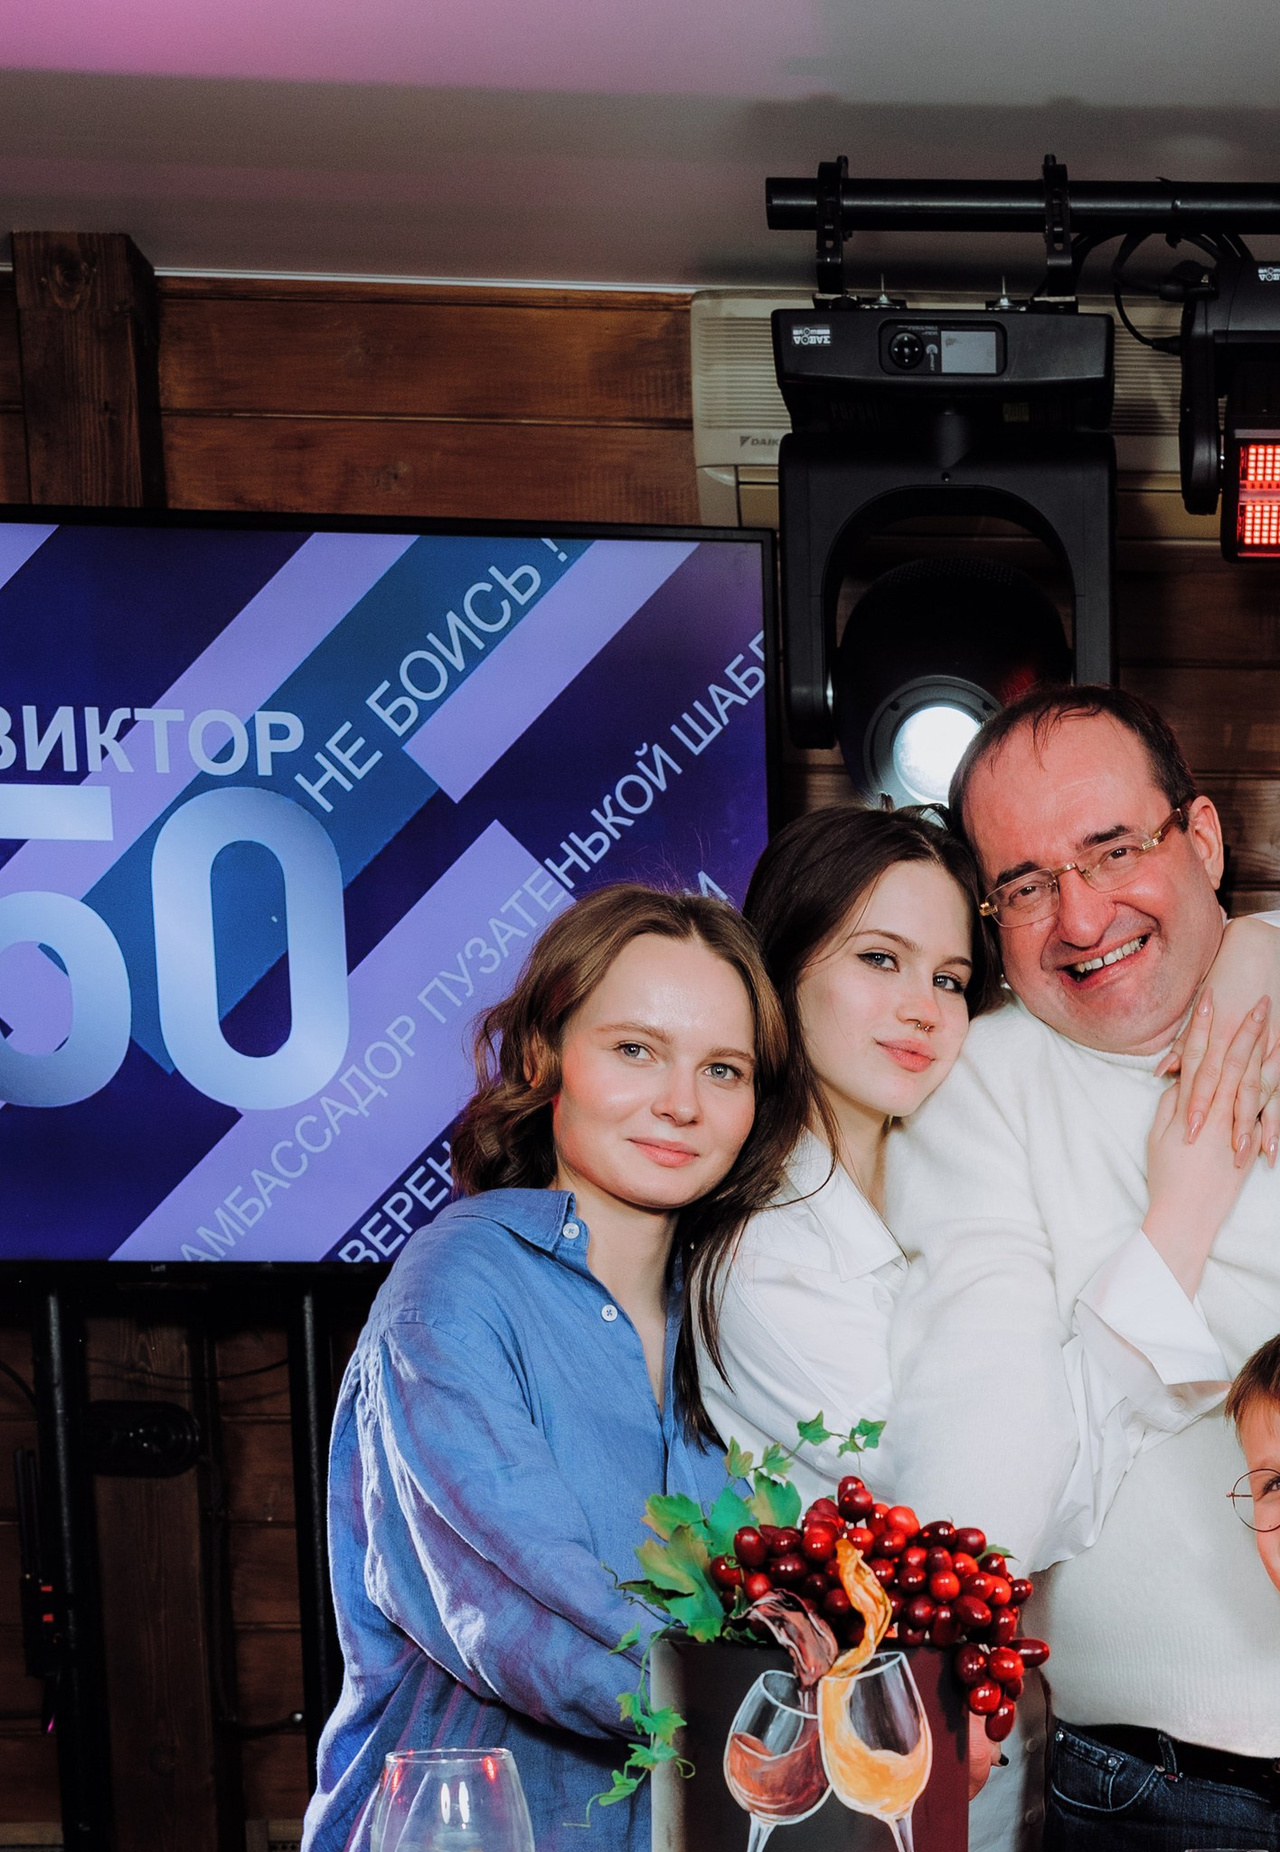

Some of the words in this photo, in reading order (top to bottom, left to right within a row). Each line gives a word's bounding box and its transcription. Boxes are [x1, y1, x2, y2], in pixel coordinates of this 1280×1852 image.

[294, 721, 383, 813] НЕ
[365, 564, 542, 737] БОИСЬ
[0, 783, 350, 1110] 50
[180, 1015, 416, 1261] АМБАССАДОР
[417, 742, 683, 1024] ПУЗАТЕНЬКОЙ
